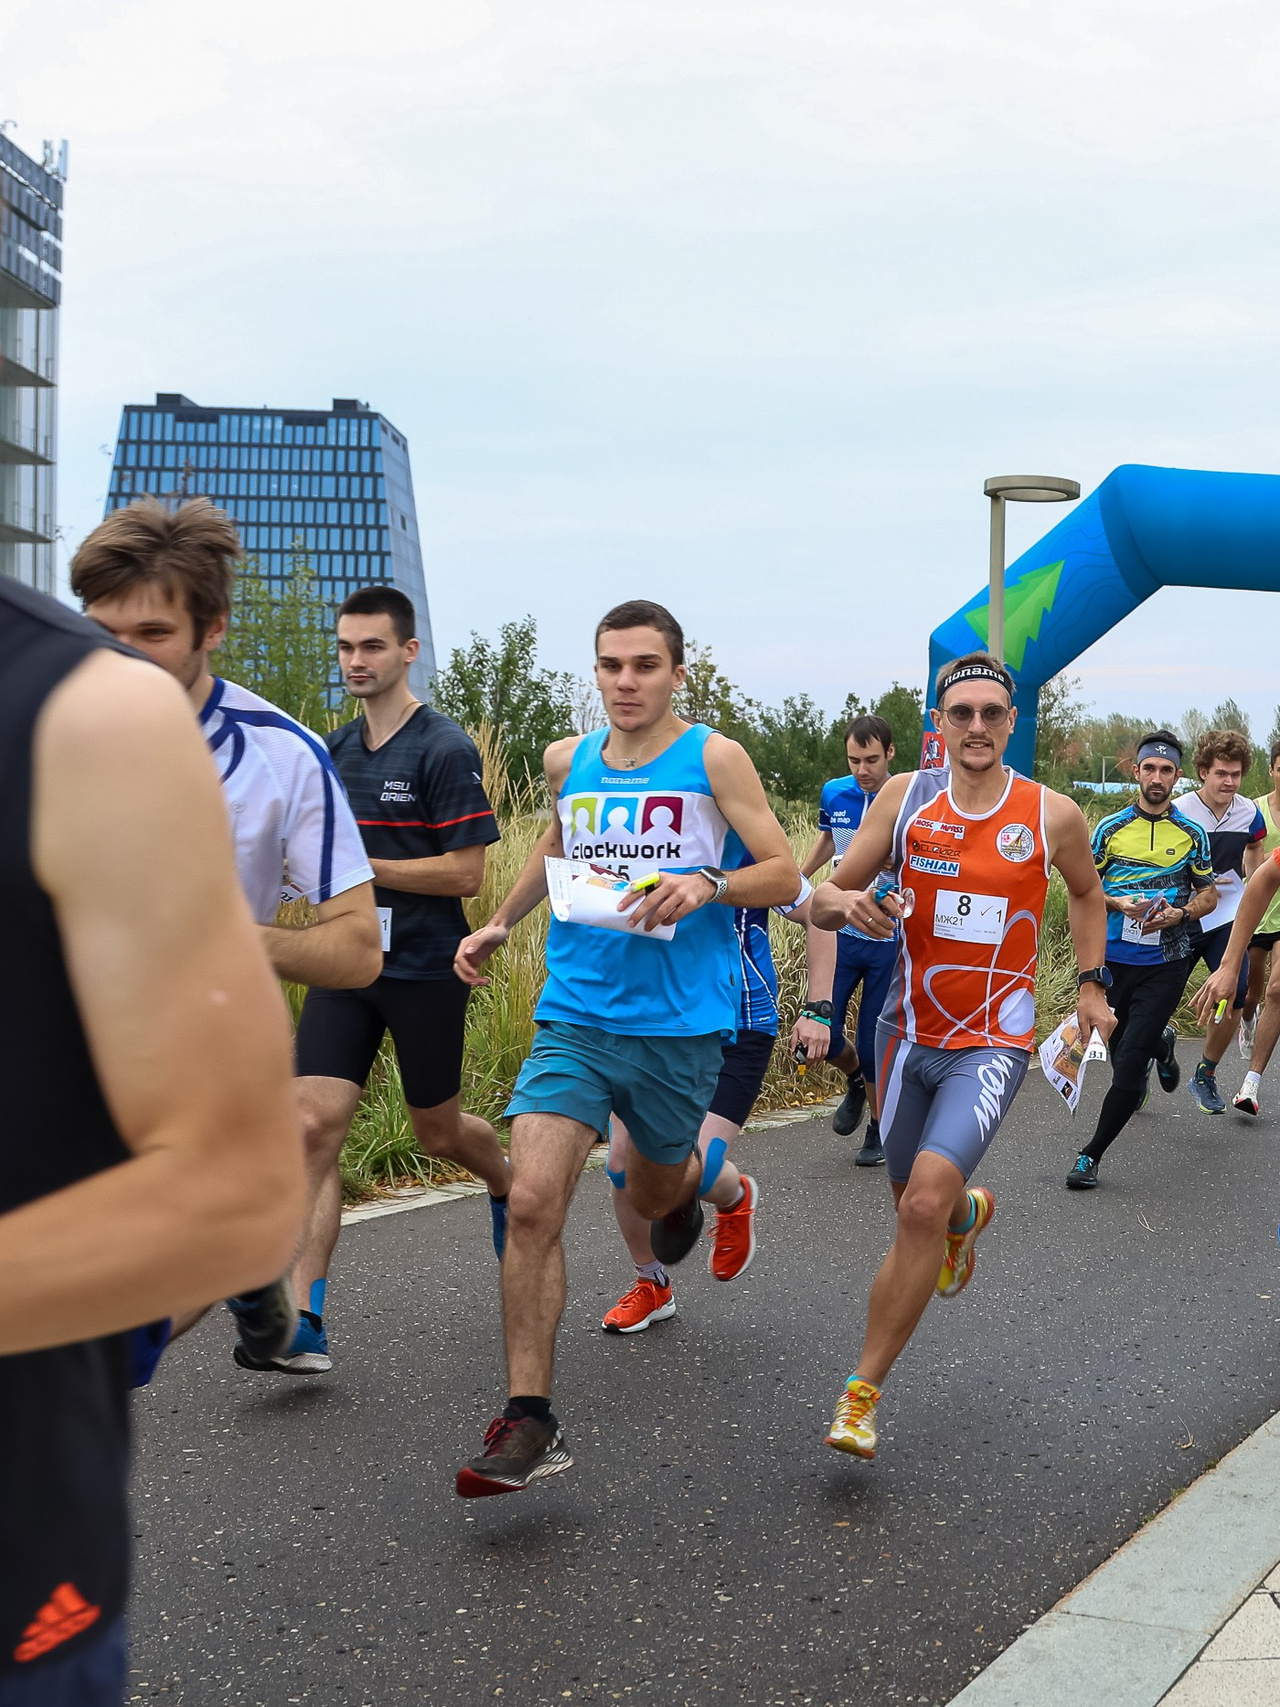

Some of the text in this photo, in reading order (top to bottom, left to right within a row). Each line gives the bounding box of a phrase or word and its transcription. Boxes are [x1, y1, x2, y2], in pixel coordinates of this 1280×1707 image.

[944, 667, 1005, 688] noname
[384, 781, 410, 791] MSU
[601, 777, 649, 785] noname
[572, 842, 682, 859] clockwork
[910, 856, 959, 873] FISHIAN
[957, 895, 1002, 923] 8 1
[935, 914, 964, 926] МЖ21
